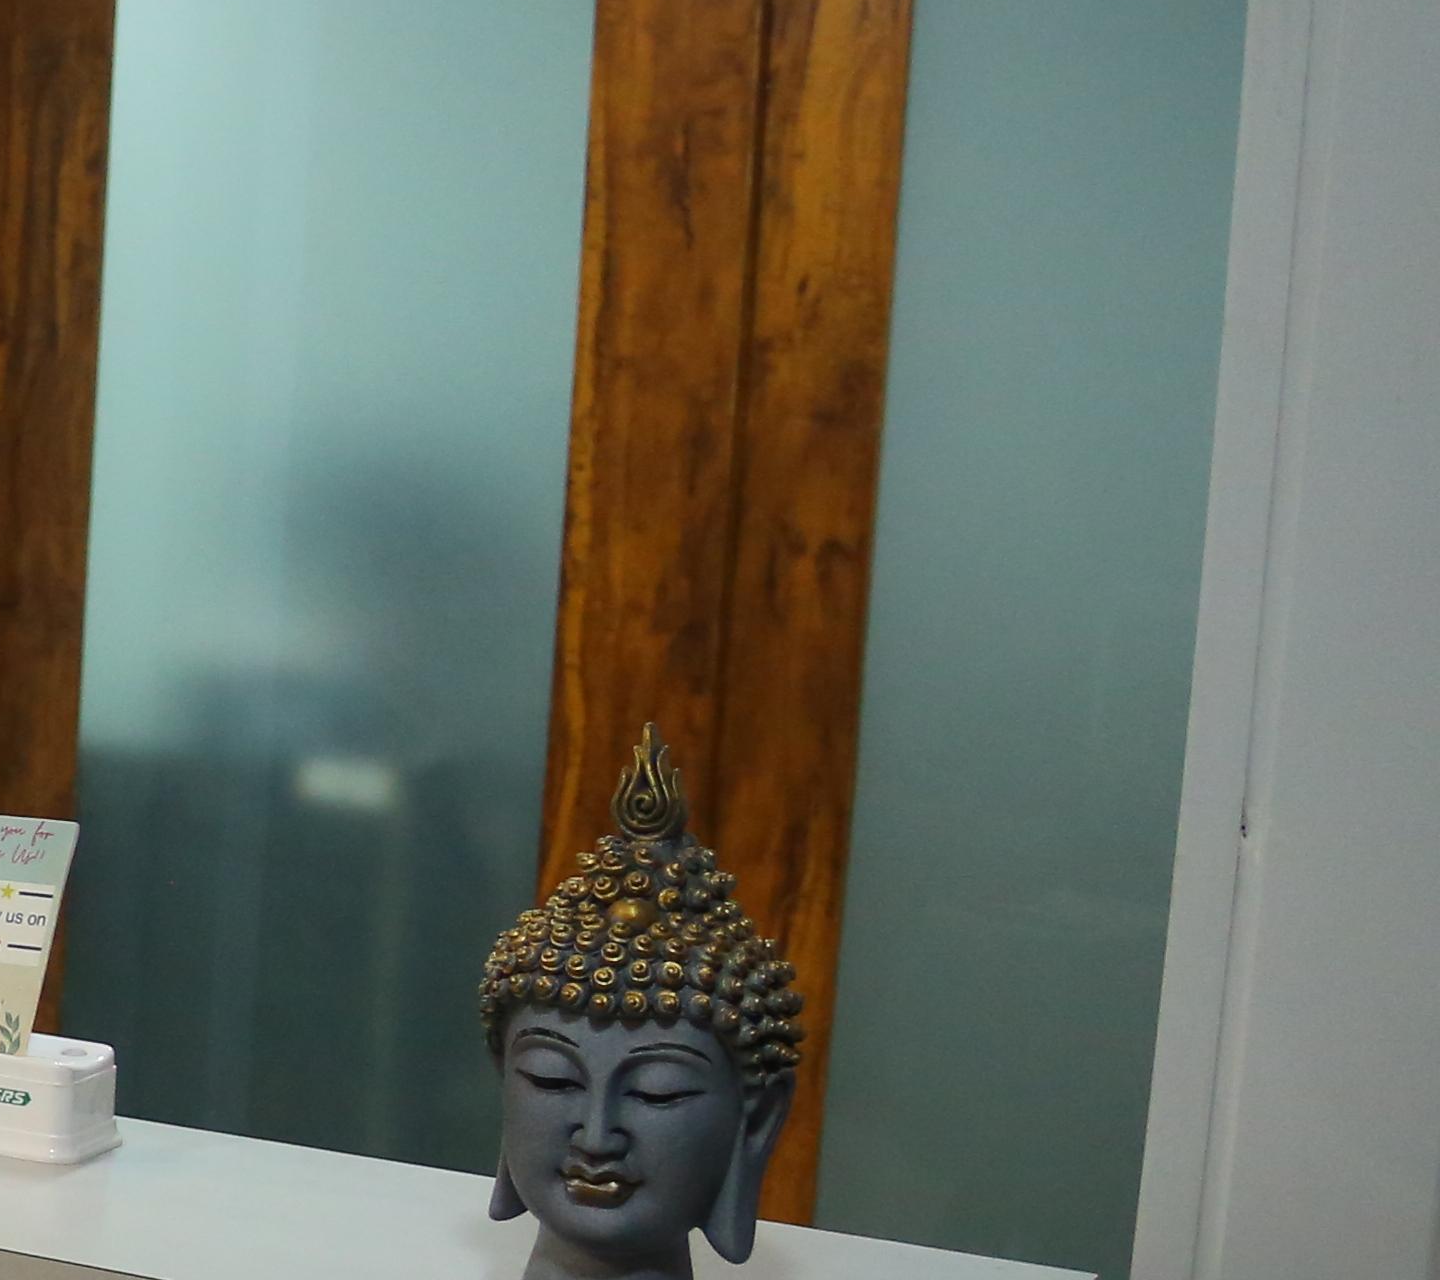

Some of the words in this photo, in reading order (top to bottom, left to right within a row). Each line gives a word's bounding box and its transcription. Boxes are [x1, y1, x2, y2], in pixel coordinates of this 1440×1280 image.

[1, 824, 27, 842] you
[31, 821, 56, 847] for
[5, 911, 24, 925] us
[27, 914, 47, 927] on
